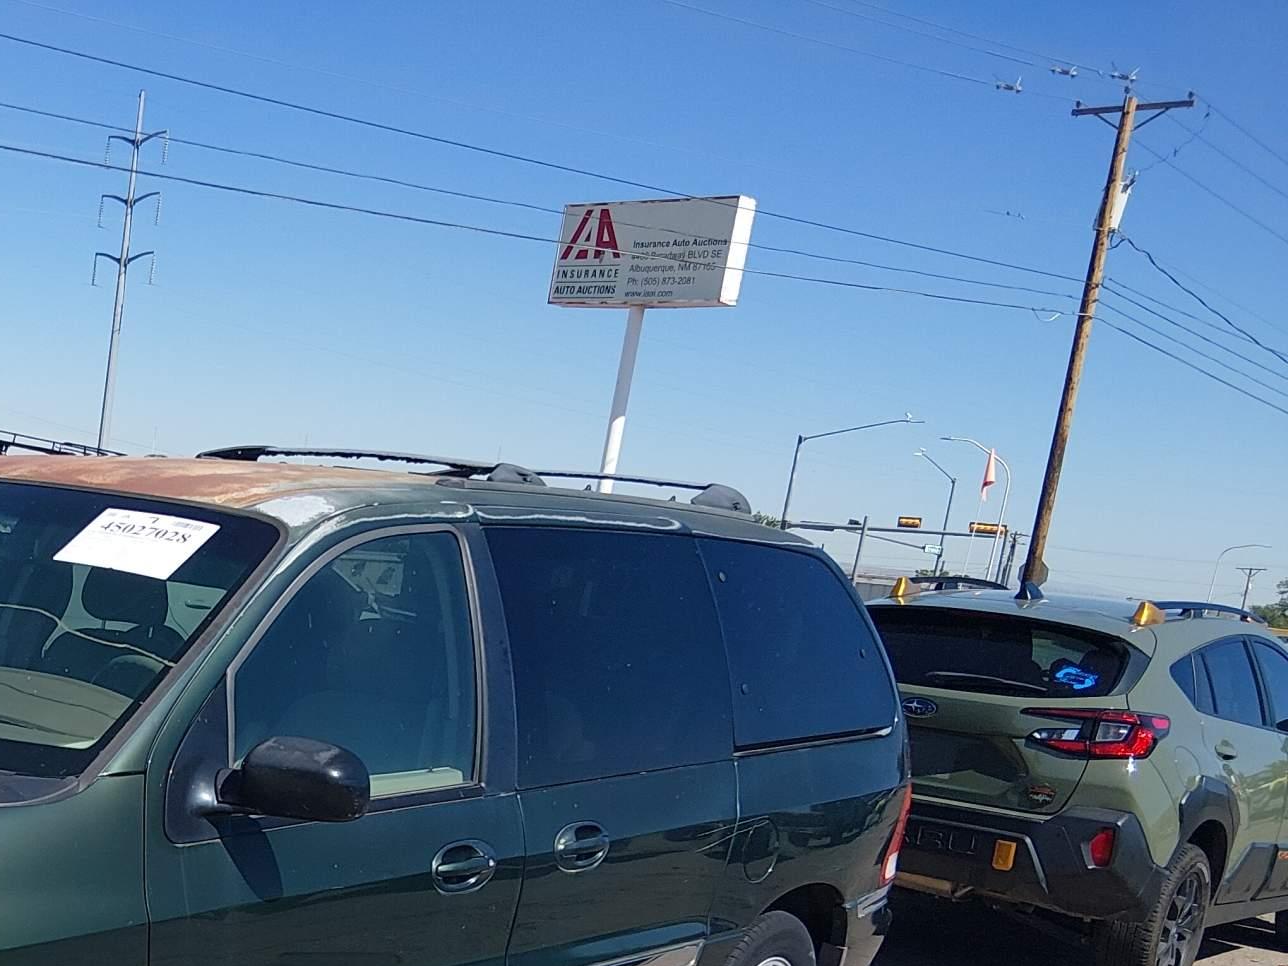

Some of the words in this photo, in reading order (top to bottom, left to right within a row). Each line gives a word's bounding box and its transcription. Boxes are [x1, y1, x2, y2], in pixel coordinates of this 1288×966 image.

[633, 239, 670, 249] Insurance
[672, 239, 690, 247] Auto
[691, 238, 728, 247] Auctions
[687, 250, 709, 259] BLVD
[710, 250, 722, 259] SE
[556, 268, 619, 279] INSURANCE
[629, 264, 676, 275] Albuquerque,
[678, 263, 692, 272] NM
[640, 276, 660, 287] (505)
[661, 276, 696, 286] 873-2081
[553, 285, 575, 296] AUTO
[576, 284, 617, 295] AUCTIONS
[100, 521, 192, 543] 45027028
